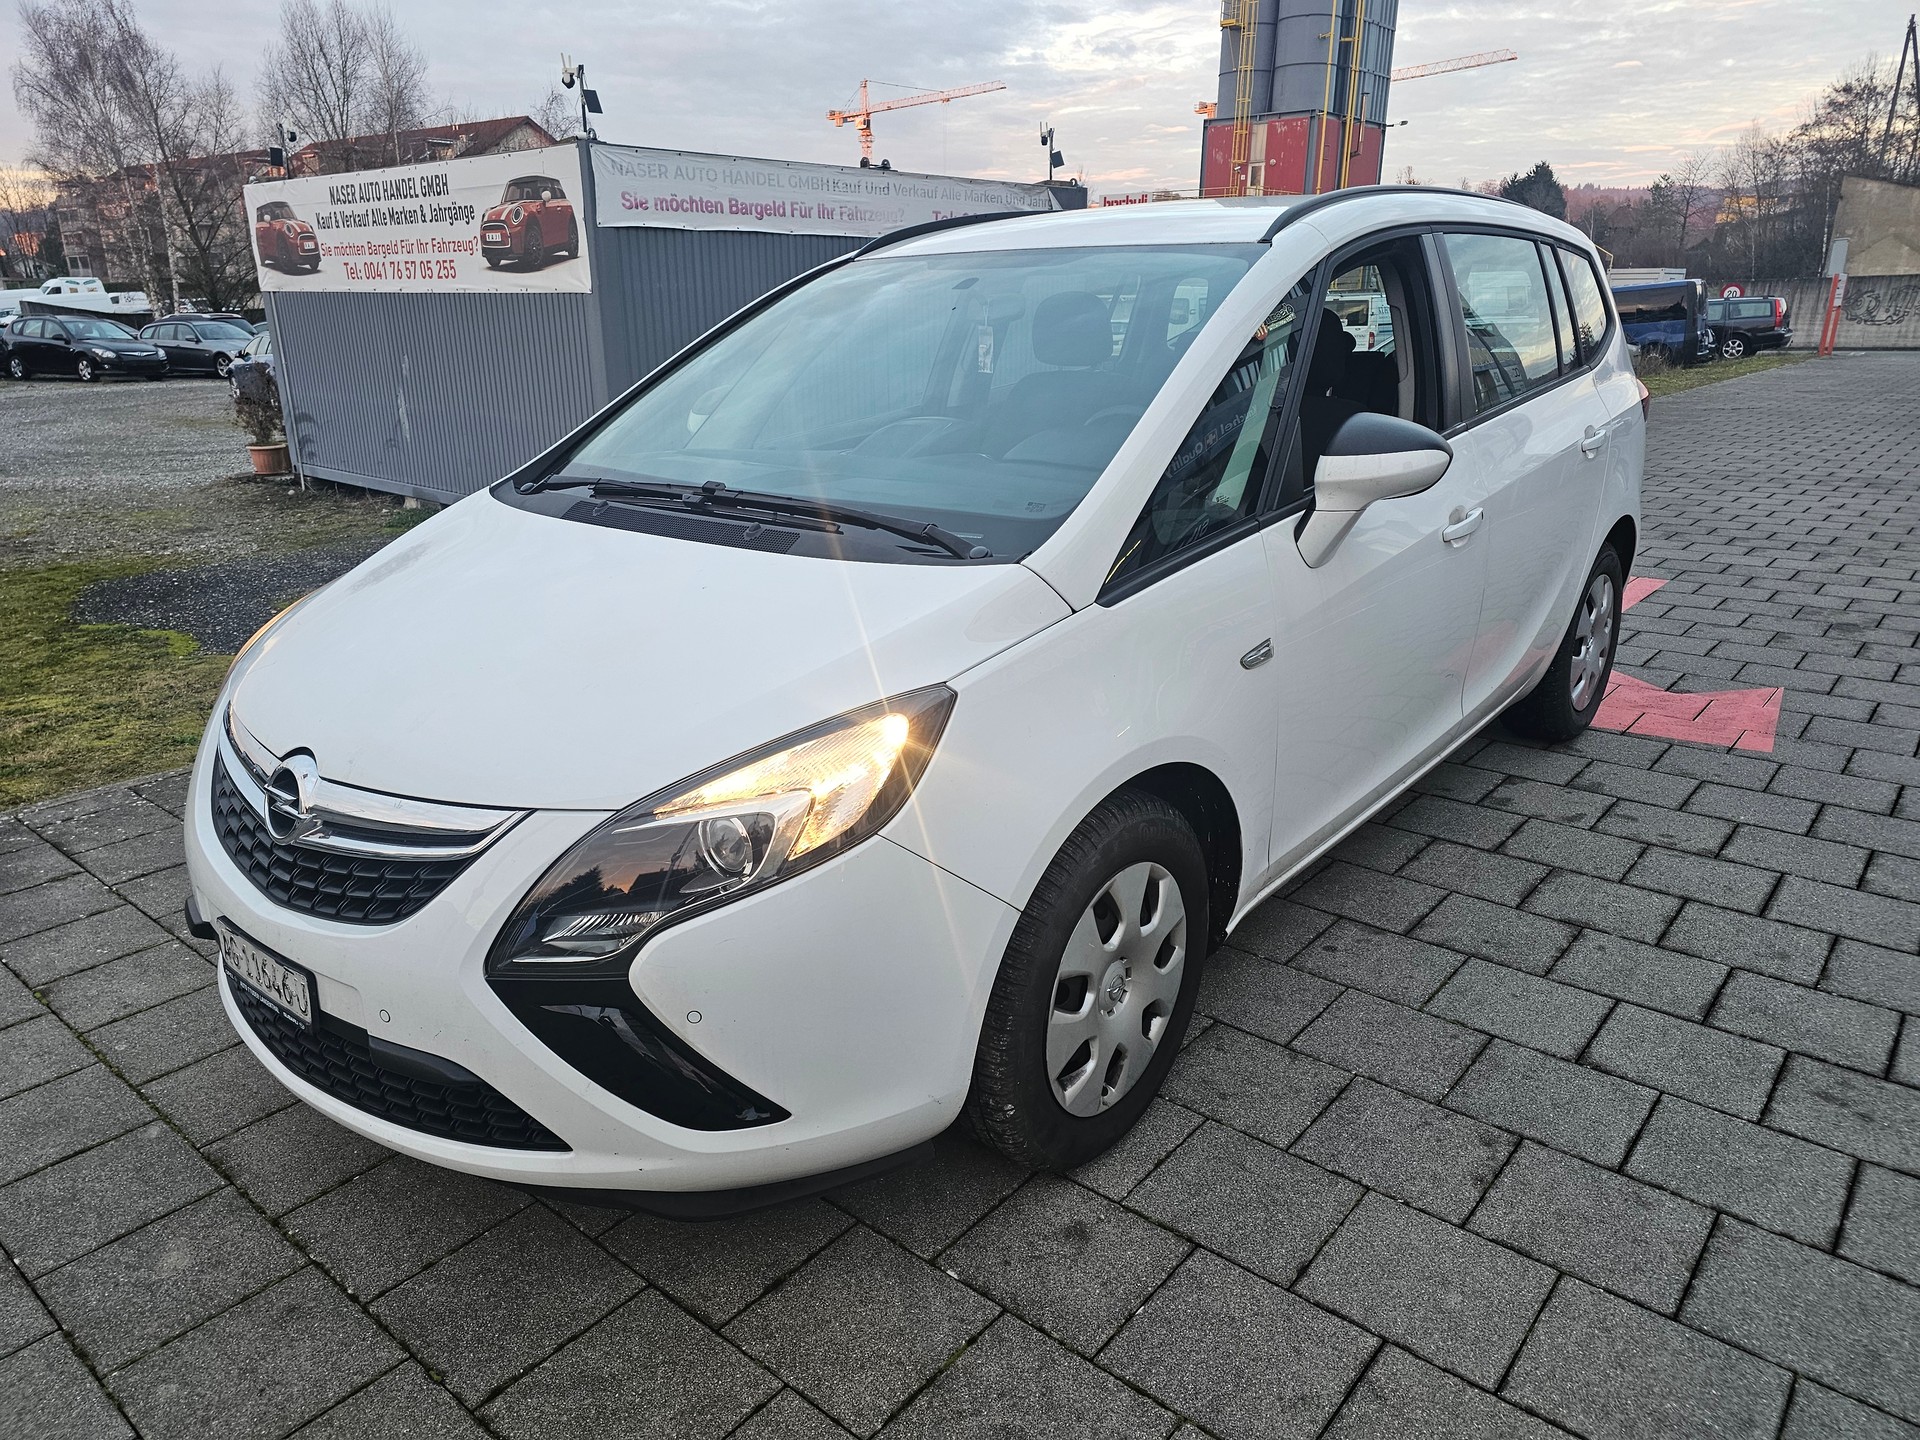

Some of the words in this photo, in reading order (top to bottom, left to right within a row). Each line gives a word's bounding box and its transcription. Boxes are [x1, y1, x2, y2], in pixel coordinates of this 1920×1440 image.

[328, 186, 356, 205] NASER
[360, 182, 381, 204] AUTO
[382, 178, 419, 200] HANDEL
[420, 174, 449, 196] GMBH
[611, 160, 669, 179] NASER
[674, 165, 718, 182] AUTO
[723, 170, 784, 188] HANDEL
[789, 175, 830, 191] GMBH
[833, 180, 862, 193] Kauf
[866, 182, 890, 196] Und
[893, 183, 938, 199] Verkauf
[941, 187, 962, 202] Alle
[964, 189, 1003, 204] Marken
[1005, 192, 1025, 206] Und
[316, 212, 334, 230] Kauf
[335, 211, 340, 229] &
[340, 208, 370, 229] Verkauf
[371, 208, 387, 227] Alle
[389, 207, 418, 226] Marken
[419, 206, 427, 223] &
[429, 203, 475, 226] Jahrgänge
[621, 191, 649, 210] Sie
[655, 193, 724, 214] möchten
[729, 198, 786, 220] Bargeld
[791, 201, 813, 218] Für
[818, 203, 835, 219] Ihr
[840, 206, 904, 224] Fahrzeug?
[321, 242, 332, 257] Sie
[334, 241, 365, 257] möchten
[367, 239, 399, 259] Bargeld
[401, 238, 415, 255] Für
[417, 237, 428, 254] Ihr
[430, 235, 478, 255] Fahrzeug?
[344, 262, 362, 280] Tel:
[364, 261, 387, 280] 0041
[389, 261, 402, 280] 76
[405, 261, 419, 279] 57
[421, 261, 436, 279] 05
[437, 260, 456, 279] 255
[1727, 290, 1738, 298] 20
